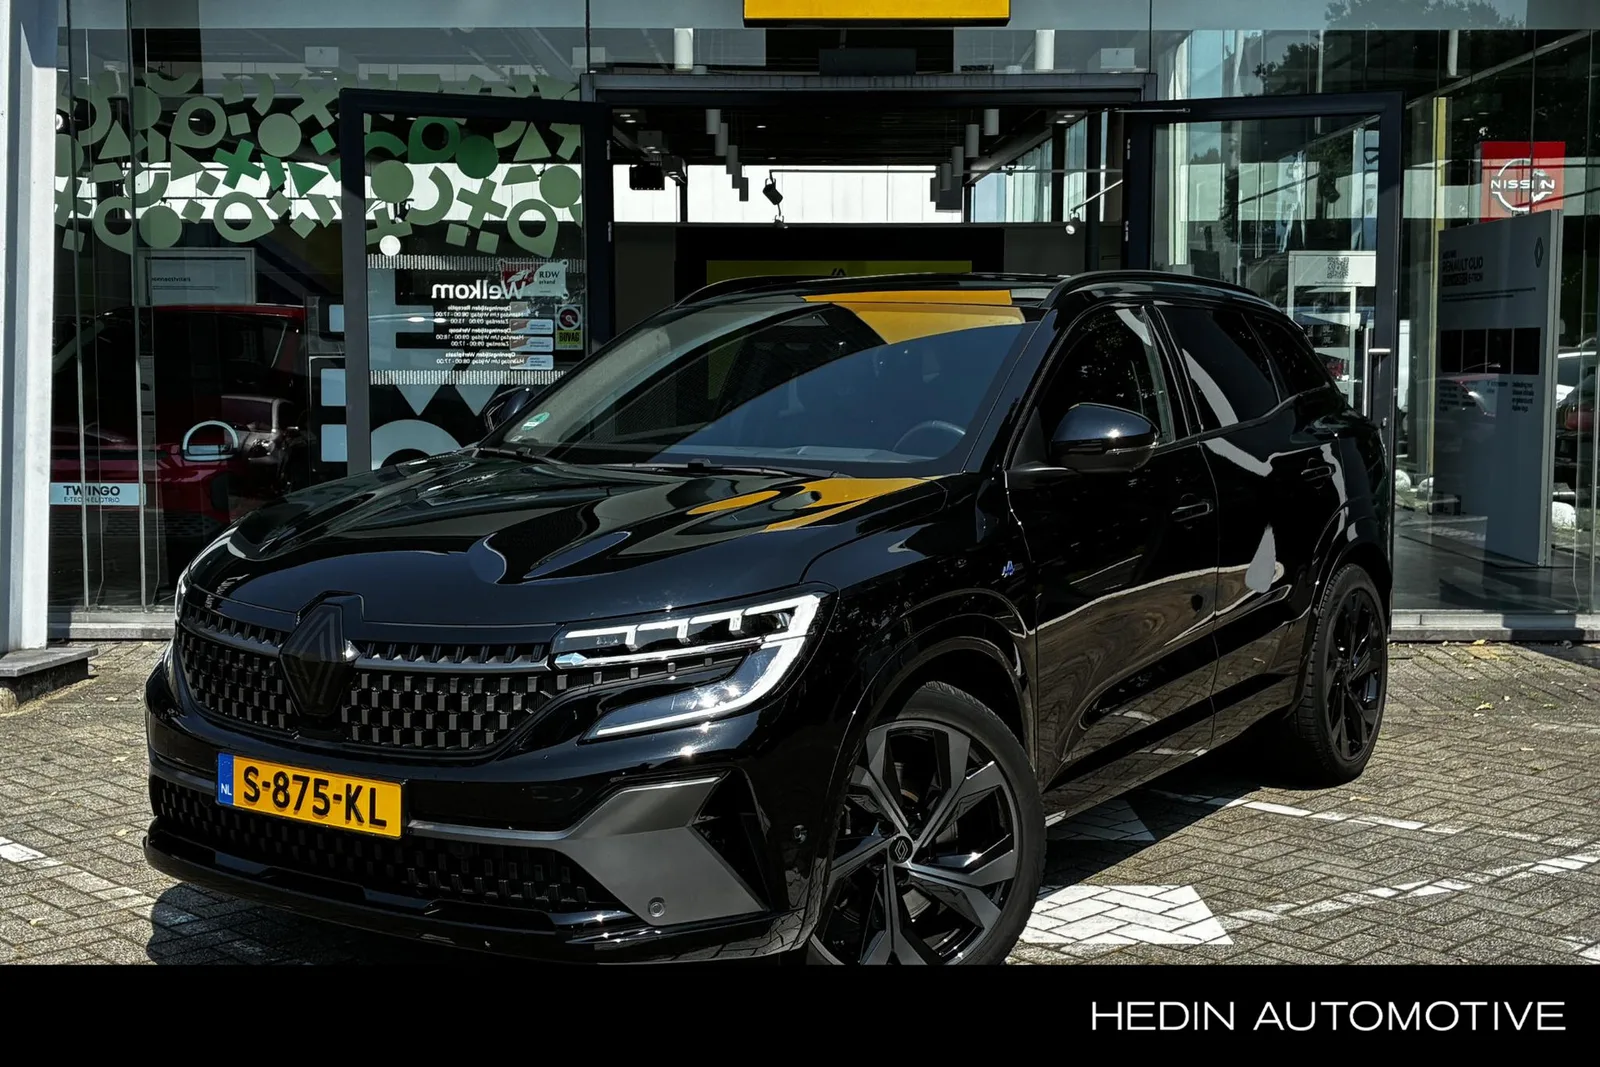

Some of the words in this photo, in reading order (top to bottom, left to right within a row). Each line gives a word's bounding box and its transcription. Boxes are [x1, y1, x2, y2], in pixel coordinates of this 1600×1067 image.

[1490, 179, 1555, 190] NISSN
[63, 485, 121, 496] TWINGO
[220, 783, 232, 796] NL
[243, 765, 387, 828] S-875-KL
